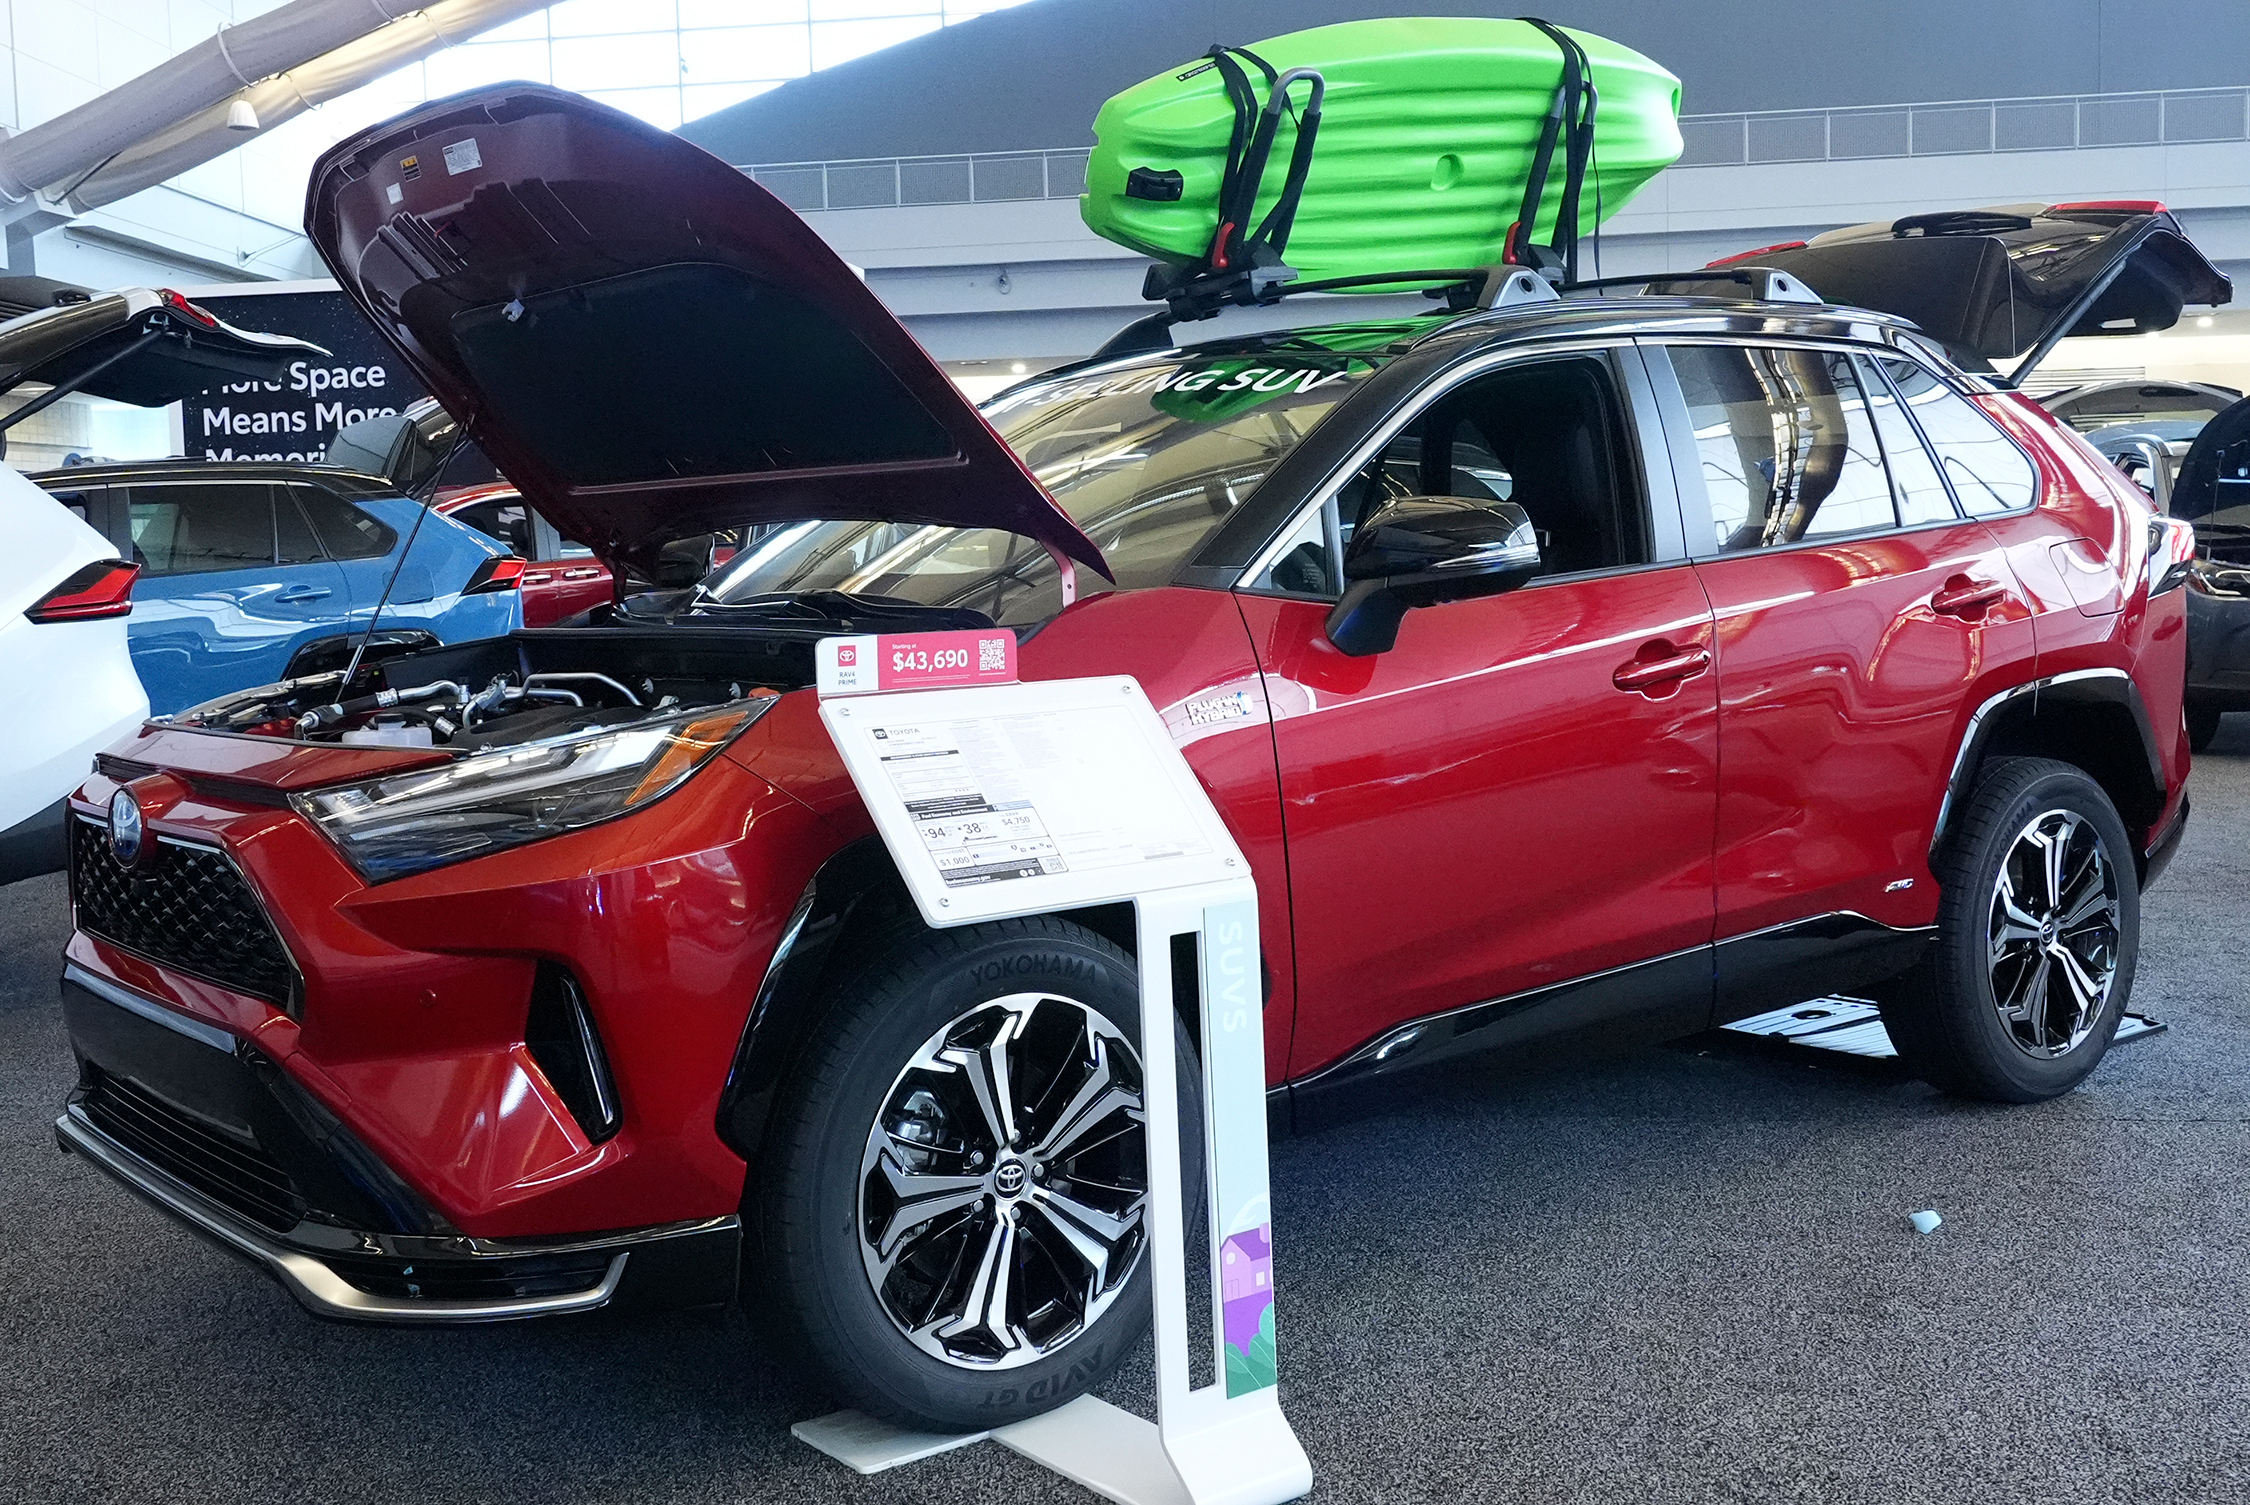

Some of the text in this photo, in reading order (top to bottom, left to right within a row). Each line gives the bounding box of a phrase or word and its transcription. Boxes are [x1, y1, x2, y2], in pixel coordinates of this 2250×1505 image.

[289, 361, 386, 398] Space
[1217, 368, 1348, 394] SUV
[202, 407, 307, 437] Means
[892, 649, 968, 673] $43,690
[1191, 706, 1243, 726] HYBRID
[889, 728, 920, 736] TOYOTA
[927, 826, 947, 839] 94
[962, 822, 982, 834] 38
[1001, 815, 1031, 826] $4,750
[939, 856, 970, 867] $1,000
[969, 953, 1096, 987] YOKOHAMA
[1218, 920, 1248, 1034] SUVS
[1025, 1342, 1105, 1404] AVID
